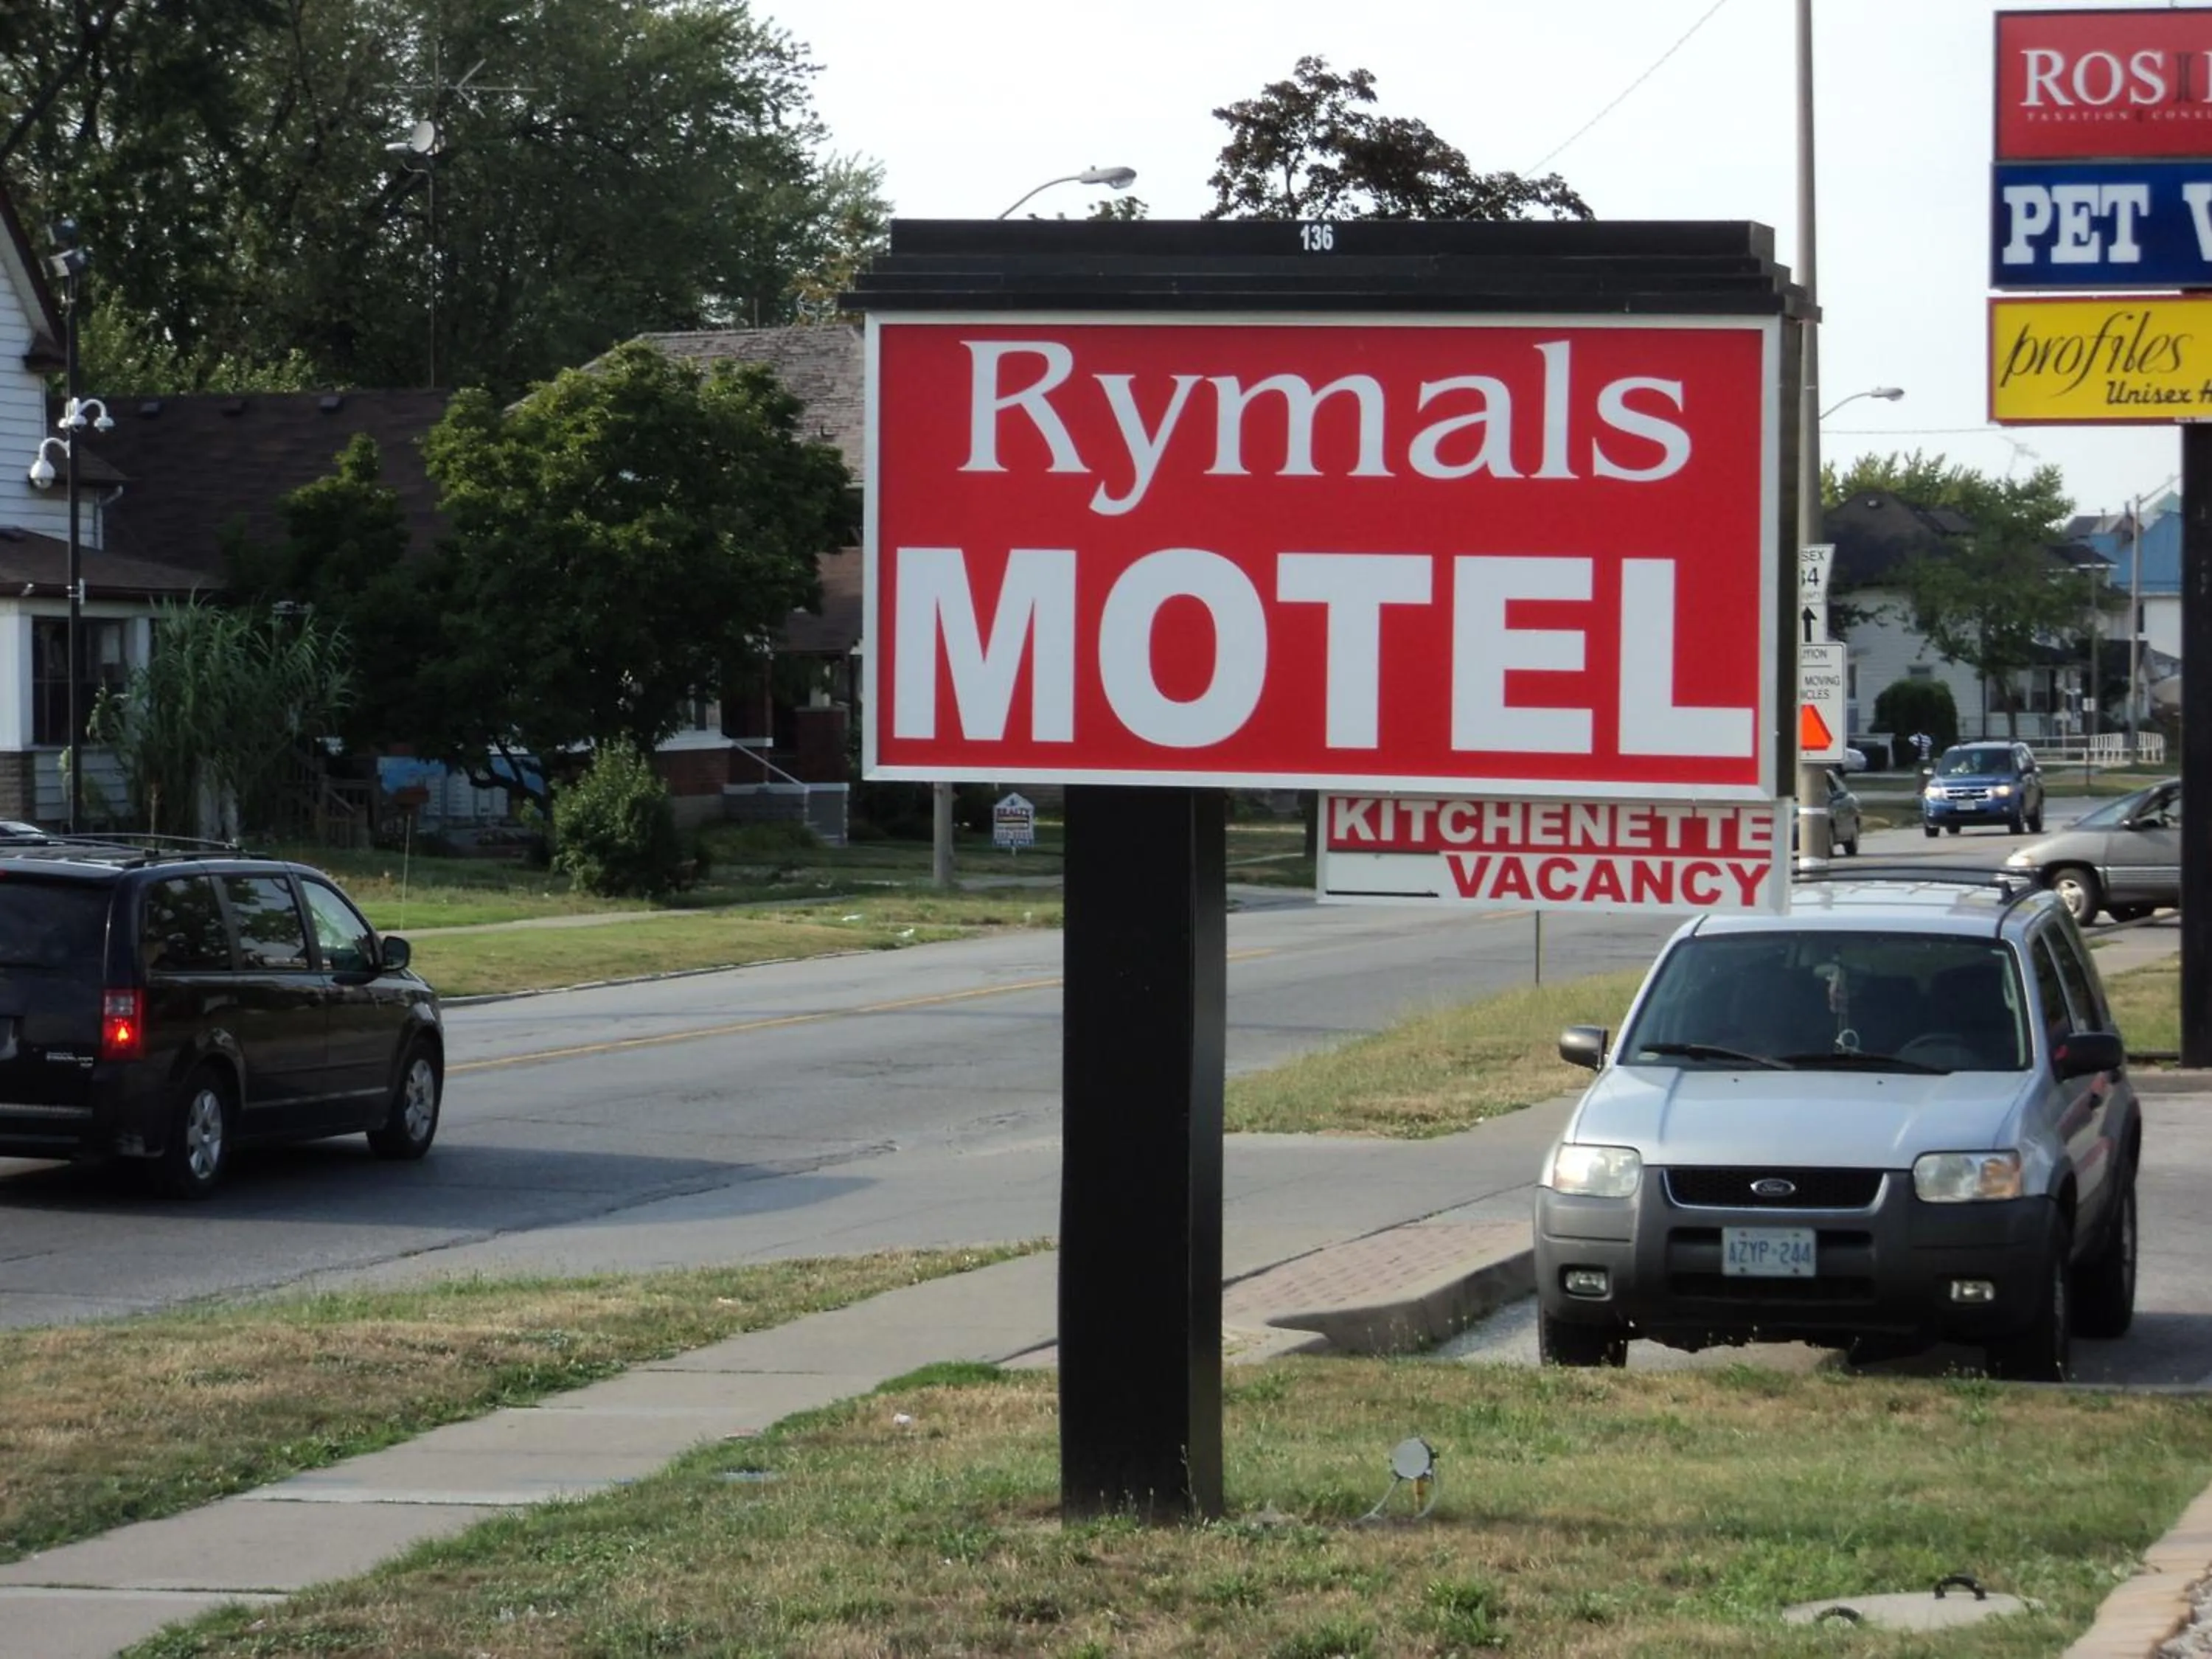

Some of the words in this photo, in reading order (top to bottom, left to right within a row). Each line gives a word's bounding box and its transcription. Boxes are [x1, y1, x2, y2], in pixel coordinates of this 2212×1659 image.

[1300, 223, 1334, 251] 136
[2003, 184, 2149, 265] PET
[1999, 310, 2195, 400] profiles
[2106, 380, 2192, 405] Unisex
[956, 340, 1693, 516] Rymals
[894, 547, 1755, 758] MOTEL
[1804, 675, 1840, 686] MOVING
[1333, 797, 1773, 851] KITCHENETTE
[1446, 855, 1770, 907] VACANCY
